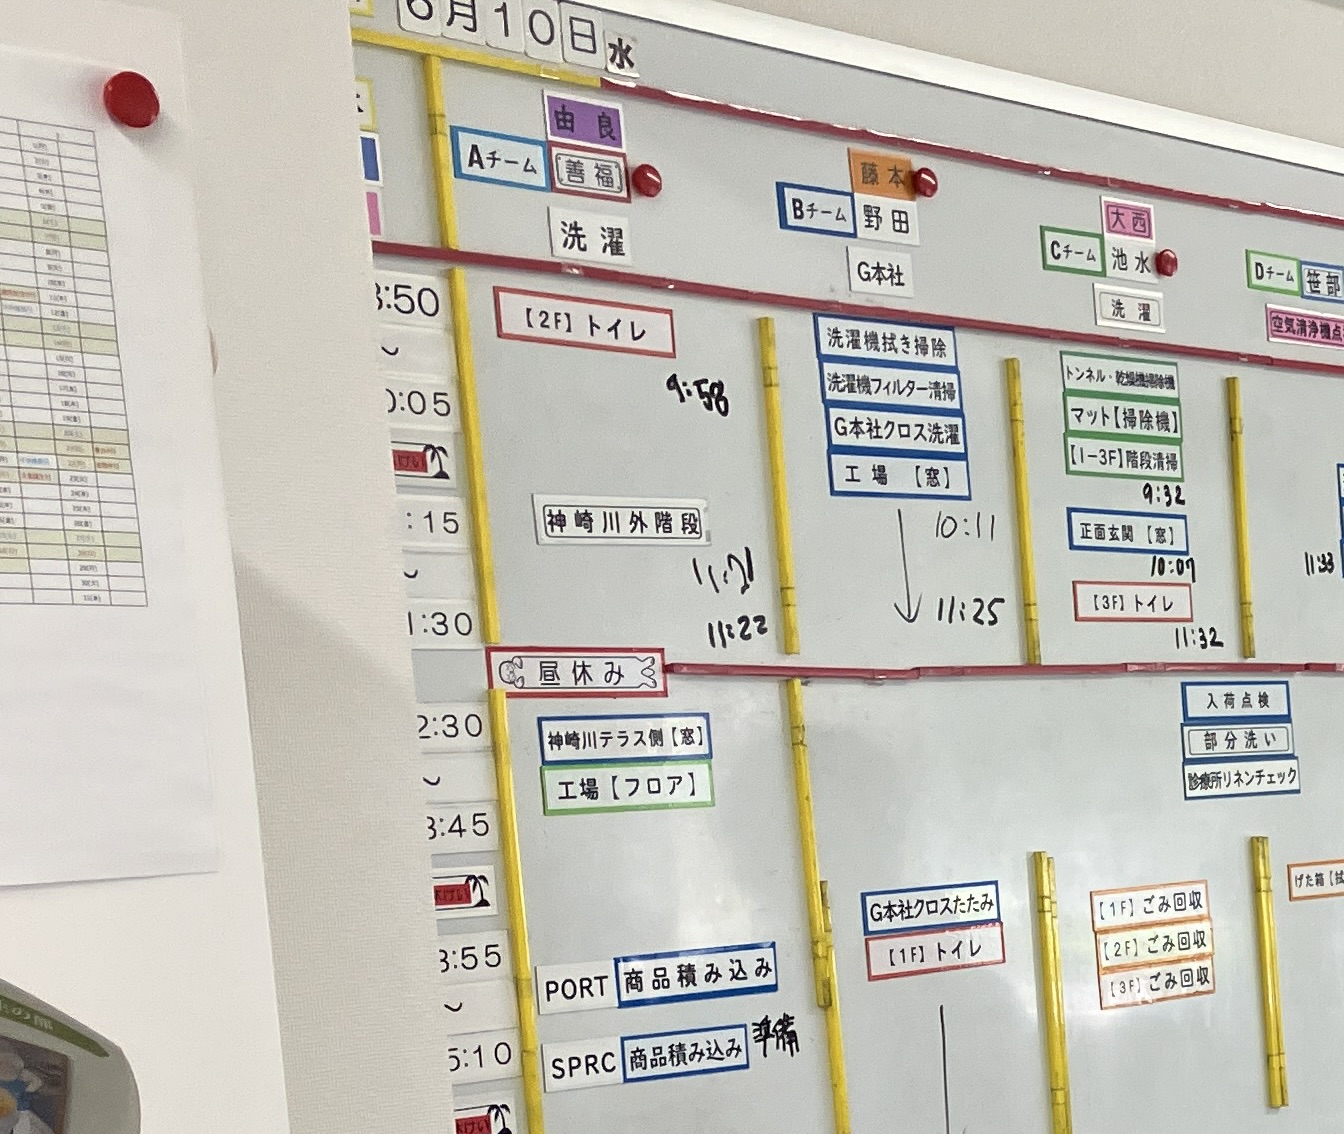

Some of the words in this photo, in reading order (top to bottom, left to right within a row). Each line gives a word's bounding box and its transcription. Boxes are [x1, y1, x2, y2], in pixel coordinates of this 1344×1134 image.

[608, 38, 635, 70] 水
[554, 104, 616, 140] 由良
[468, 145, 538, 175] Aチーム
[792, 198, 847, 222] Bチーム
[863, 204, 910, 234] 野田
[1110, 208, 1147, 233] 大西
[560, 220, 626, 256] 洗濯
[1050, 240, 1097, 262] Cチーム
[857, 261, 905, 287] G本社
[1254, 262, 1295, 283] Dチーム
[1111, 298, 1151, 322] 洗濯
[827, 327, 947, 358] 洗濯機拭き掃除
[827, 372, 956, 402] 洗濯機フィルター清掃
[834, 417, 960, 445] G本社クロス洗濯
[1143, 483, 1185, 507] 9:32
[546, 510, 701, 535] 神崎川外階段
[936, 510, 995, 541] 10:11
[938, 596, 1005, 626] 11:25
[1175, 626, 1224, 649] 11:32
[538, 660, 625, 686] 昼休み
[1207, 691, 1270, 709] 入荷点検
[1204, 730, 1276, 751] 部分洗い
[1188, 767, 1296, 790] 診療所リネンチェック
[870, 893, 994, 922] G本社クロスたたみ
[545, 975, 609, 1002] PORT
[624, 957, 773, 995] 商品積み込み
[752, 1013, 800, 1058] 準備
[551, 1052, 616, 1079] SPRC
[630, 1038, 743, 1072] 商品積み込み
